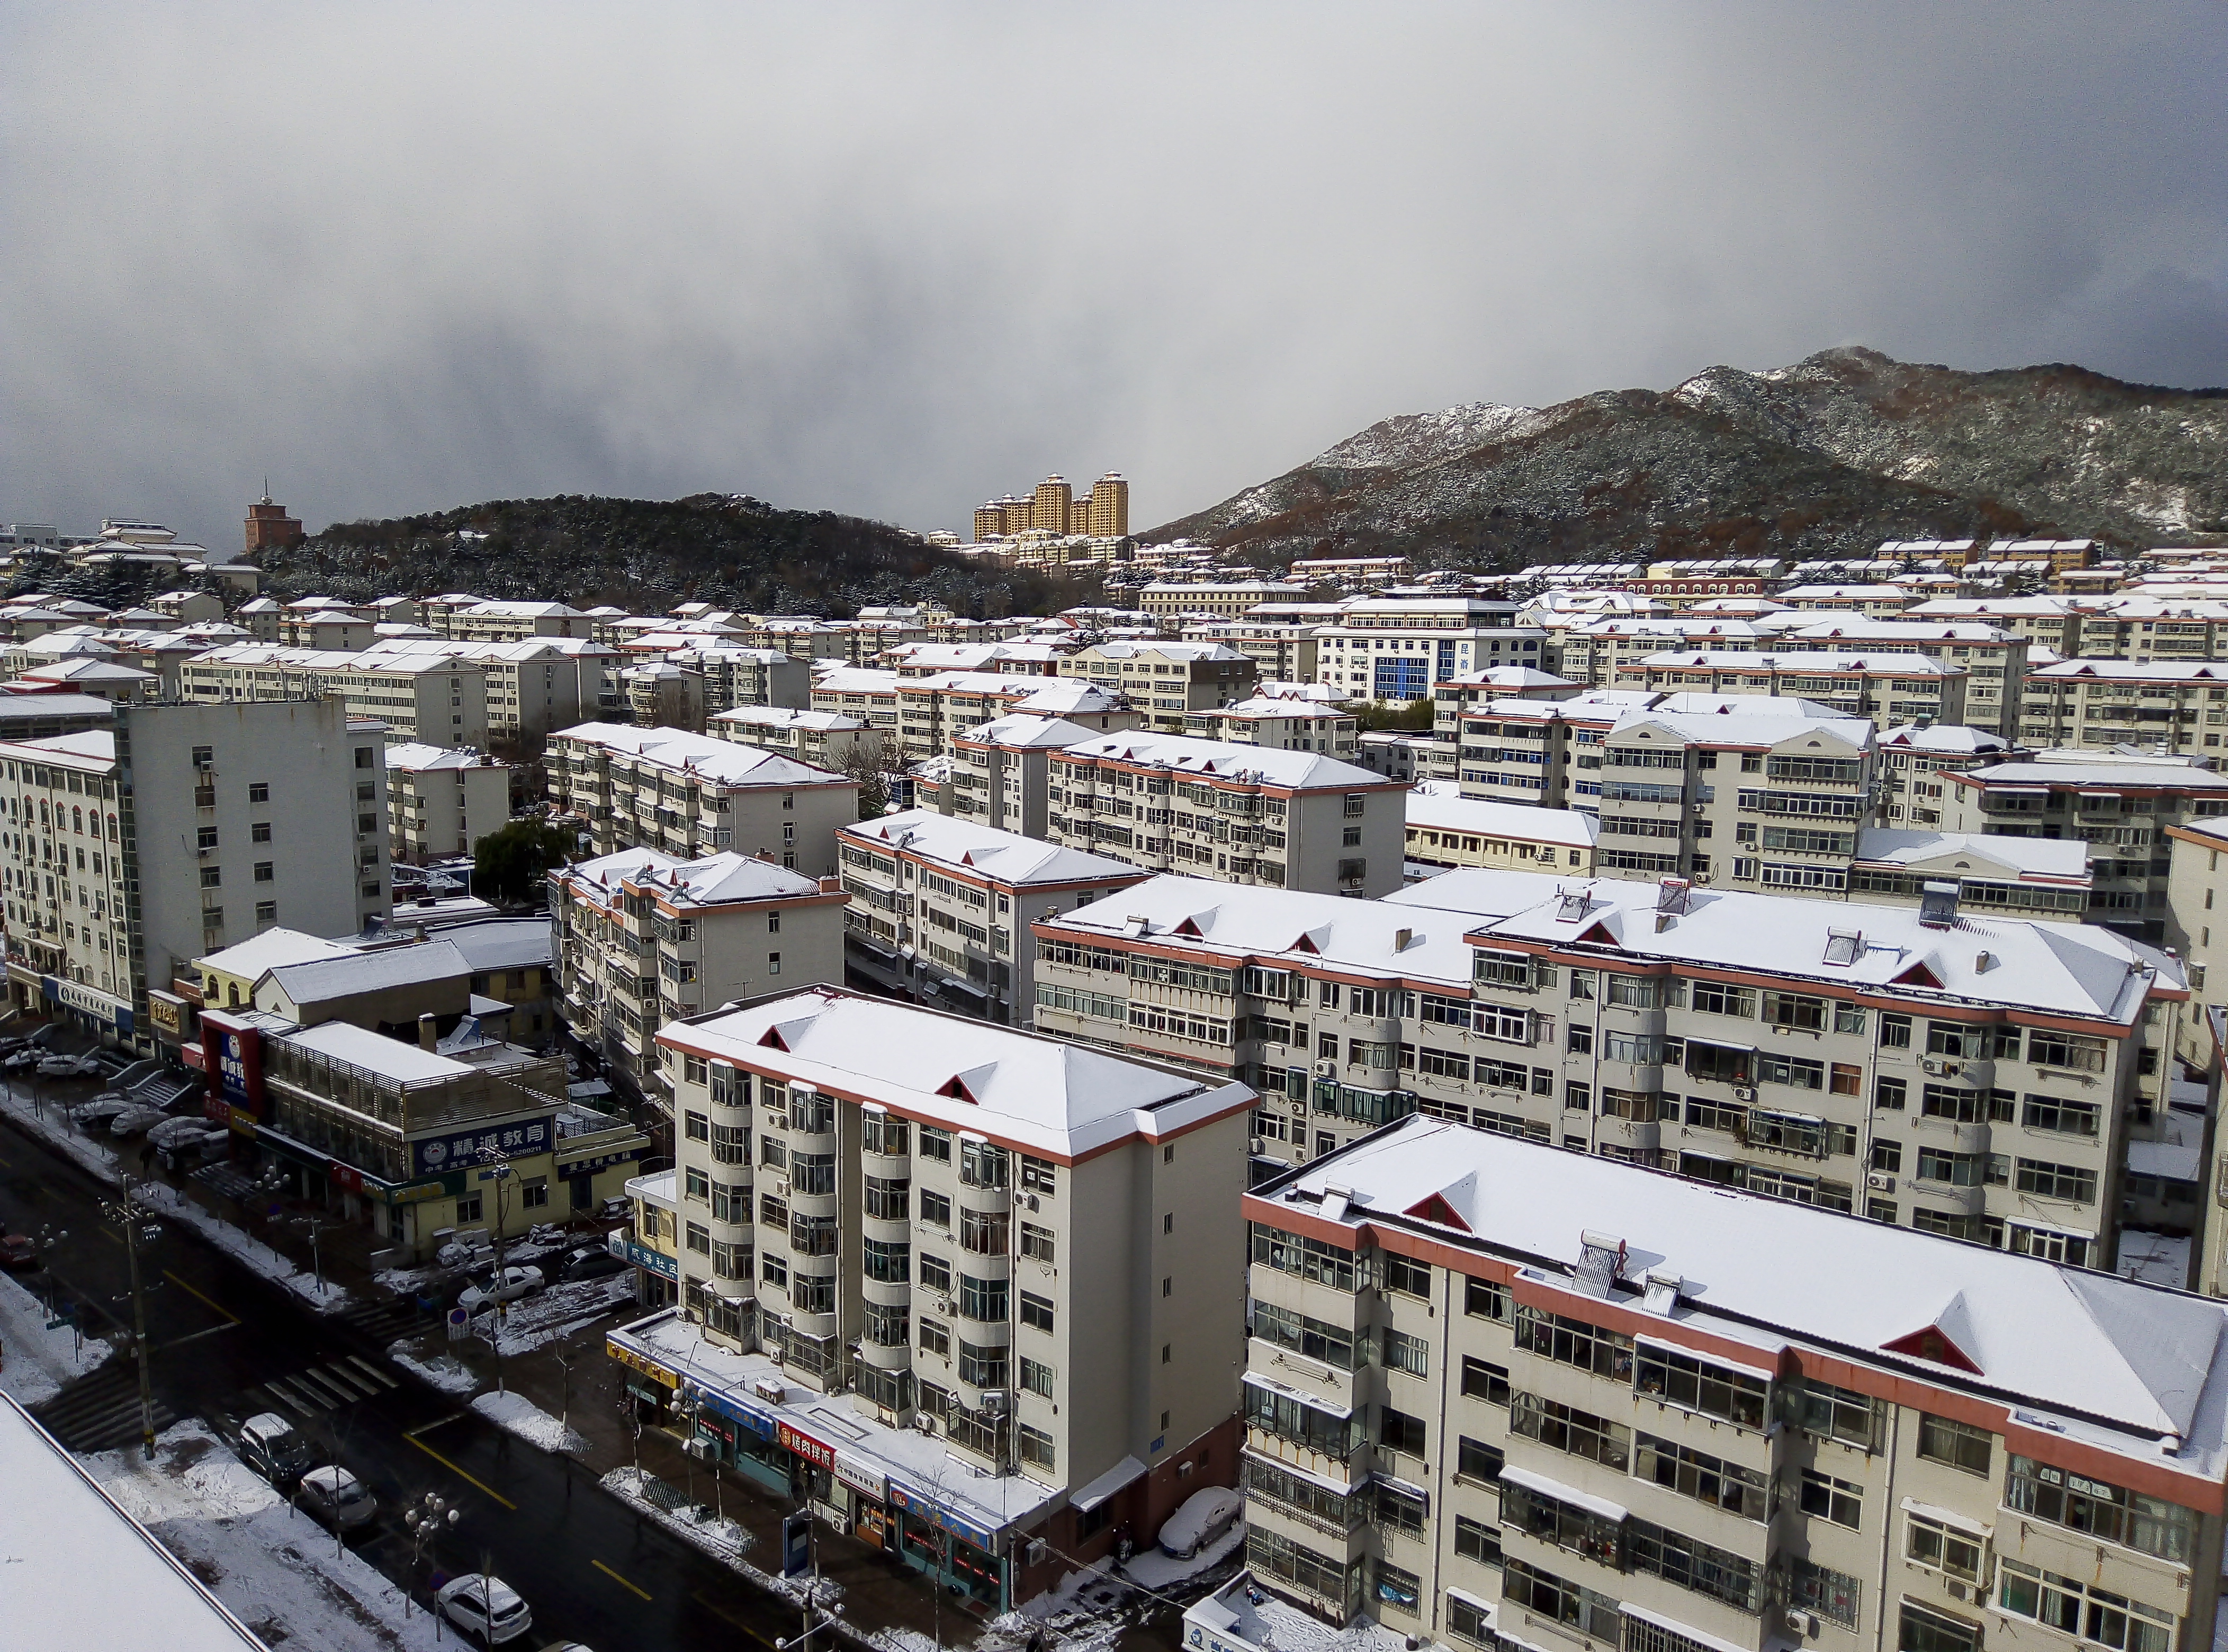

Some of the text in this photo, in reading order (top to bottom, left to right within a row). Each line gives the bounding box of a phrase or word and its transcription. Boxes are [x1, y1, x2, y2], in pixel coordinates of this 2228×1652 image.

[453, 1124, 544, 1157] 精诚教育
[631, 1247, 678, 1275] 威海社区
[792, 1433, 831, 1467] 烤肉拌饭
